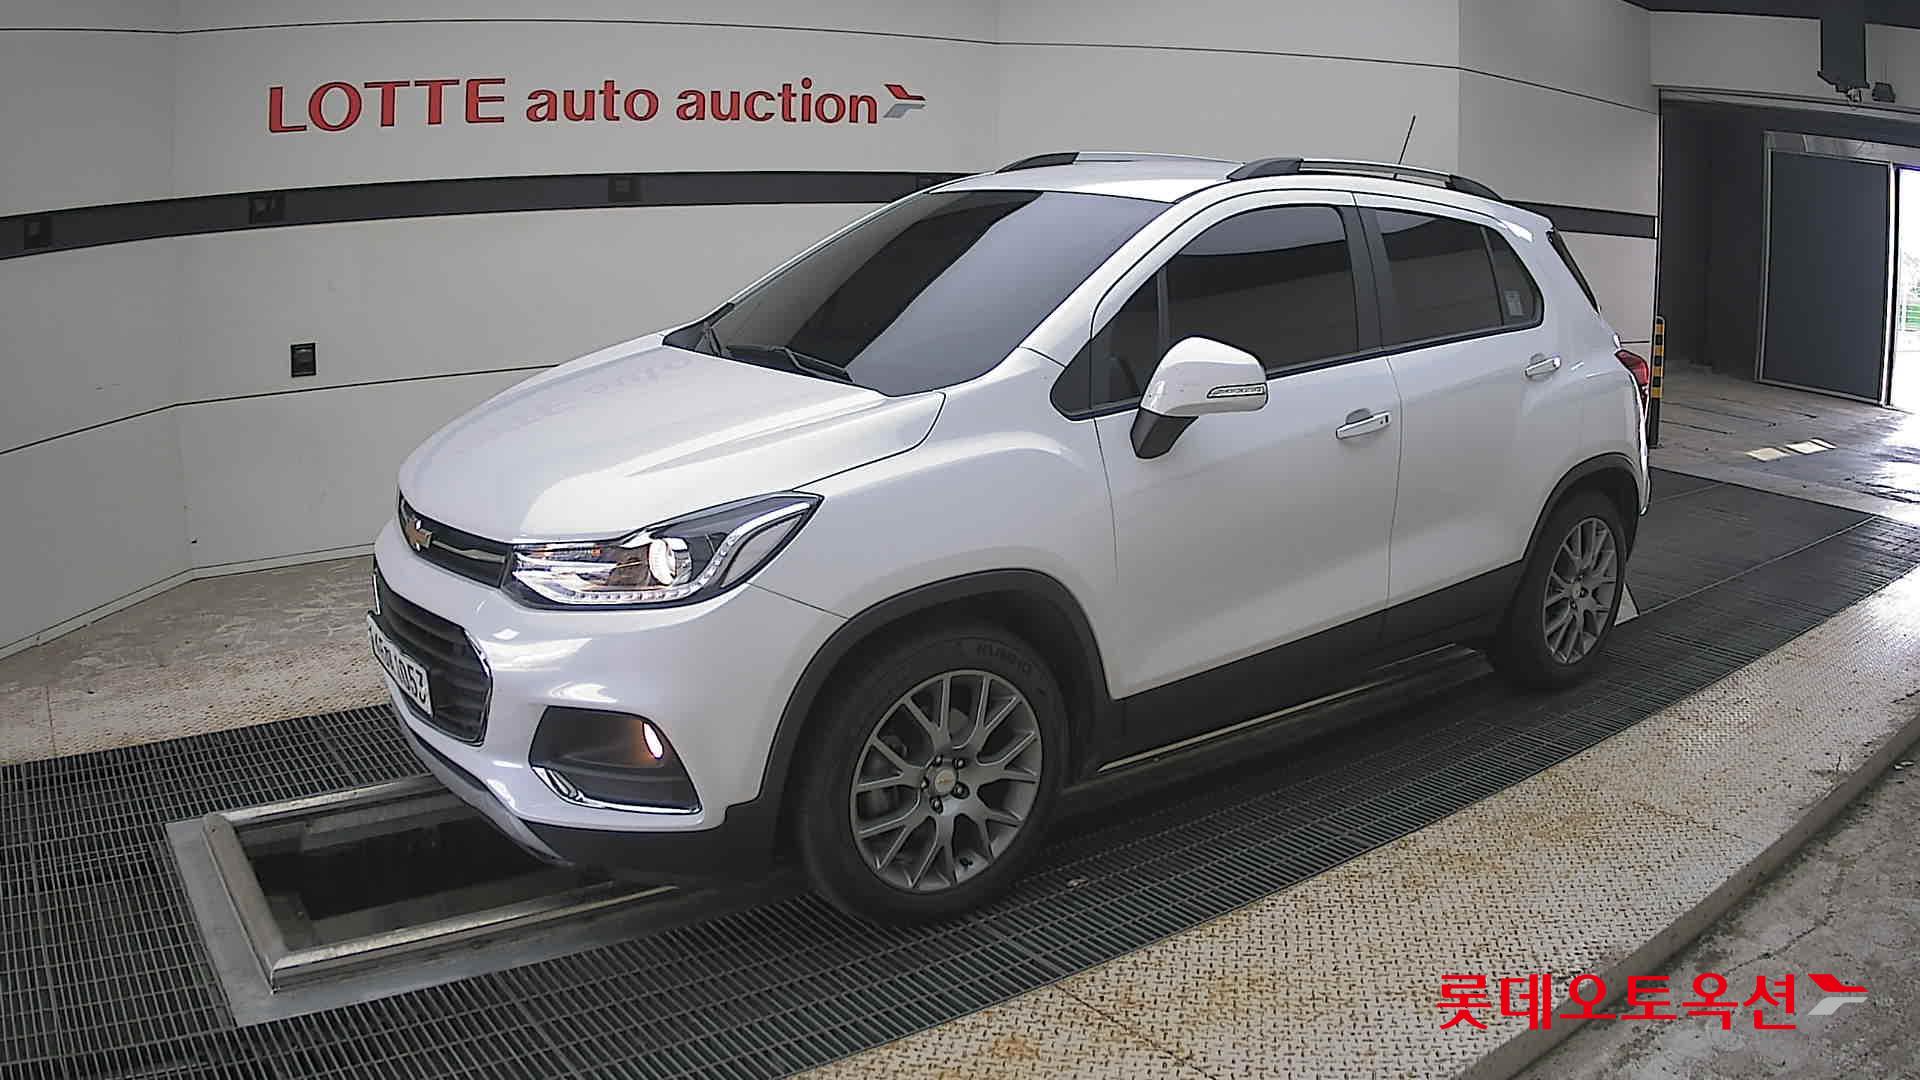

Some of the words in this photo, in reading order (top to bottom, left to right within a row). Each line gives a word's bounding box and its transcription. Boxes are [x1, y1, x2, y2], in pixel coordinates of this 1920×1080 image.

[267, 78, 505, 133] LOTTE
[526, 79, 660, 123] auto
[675, 77, 880, 125] auction
